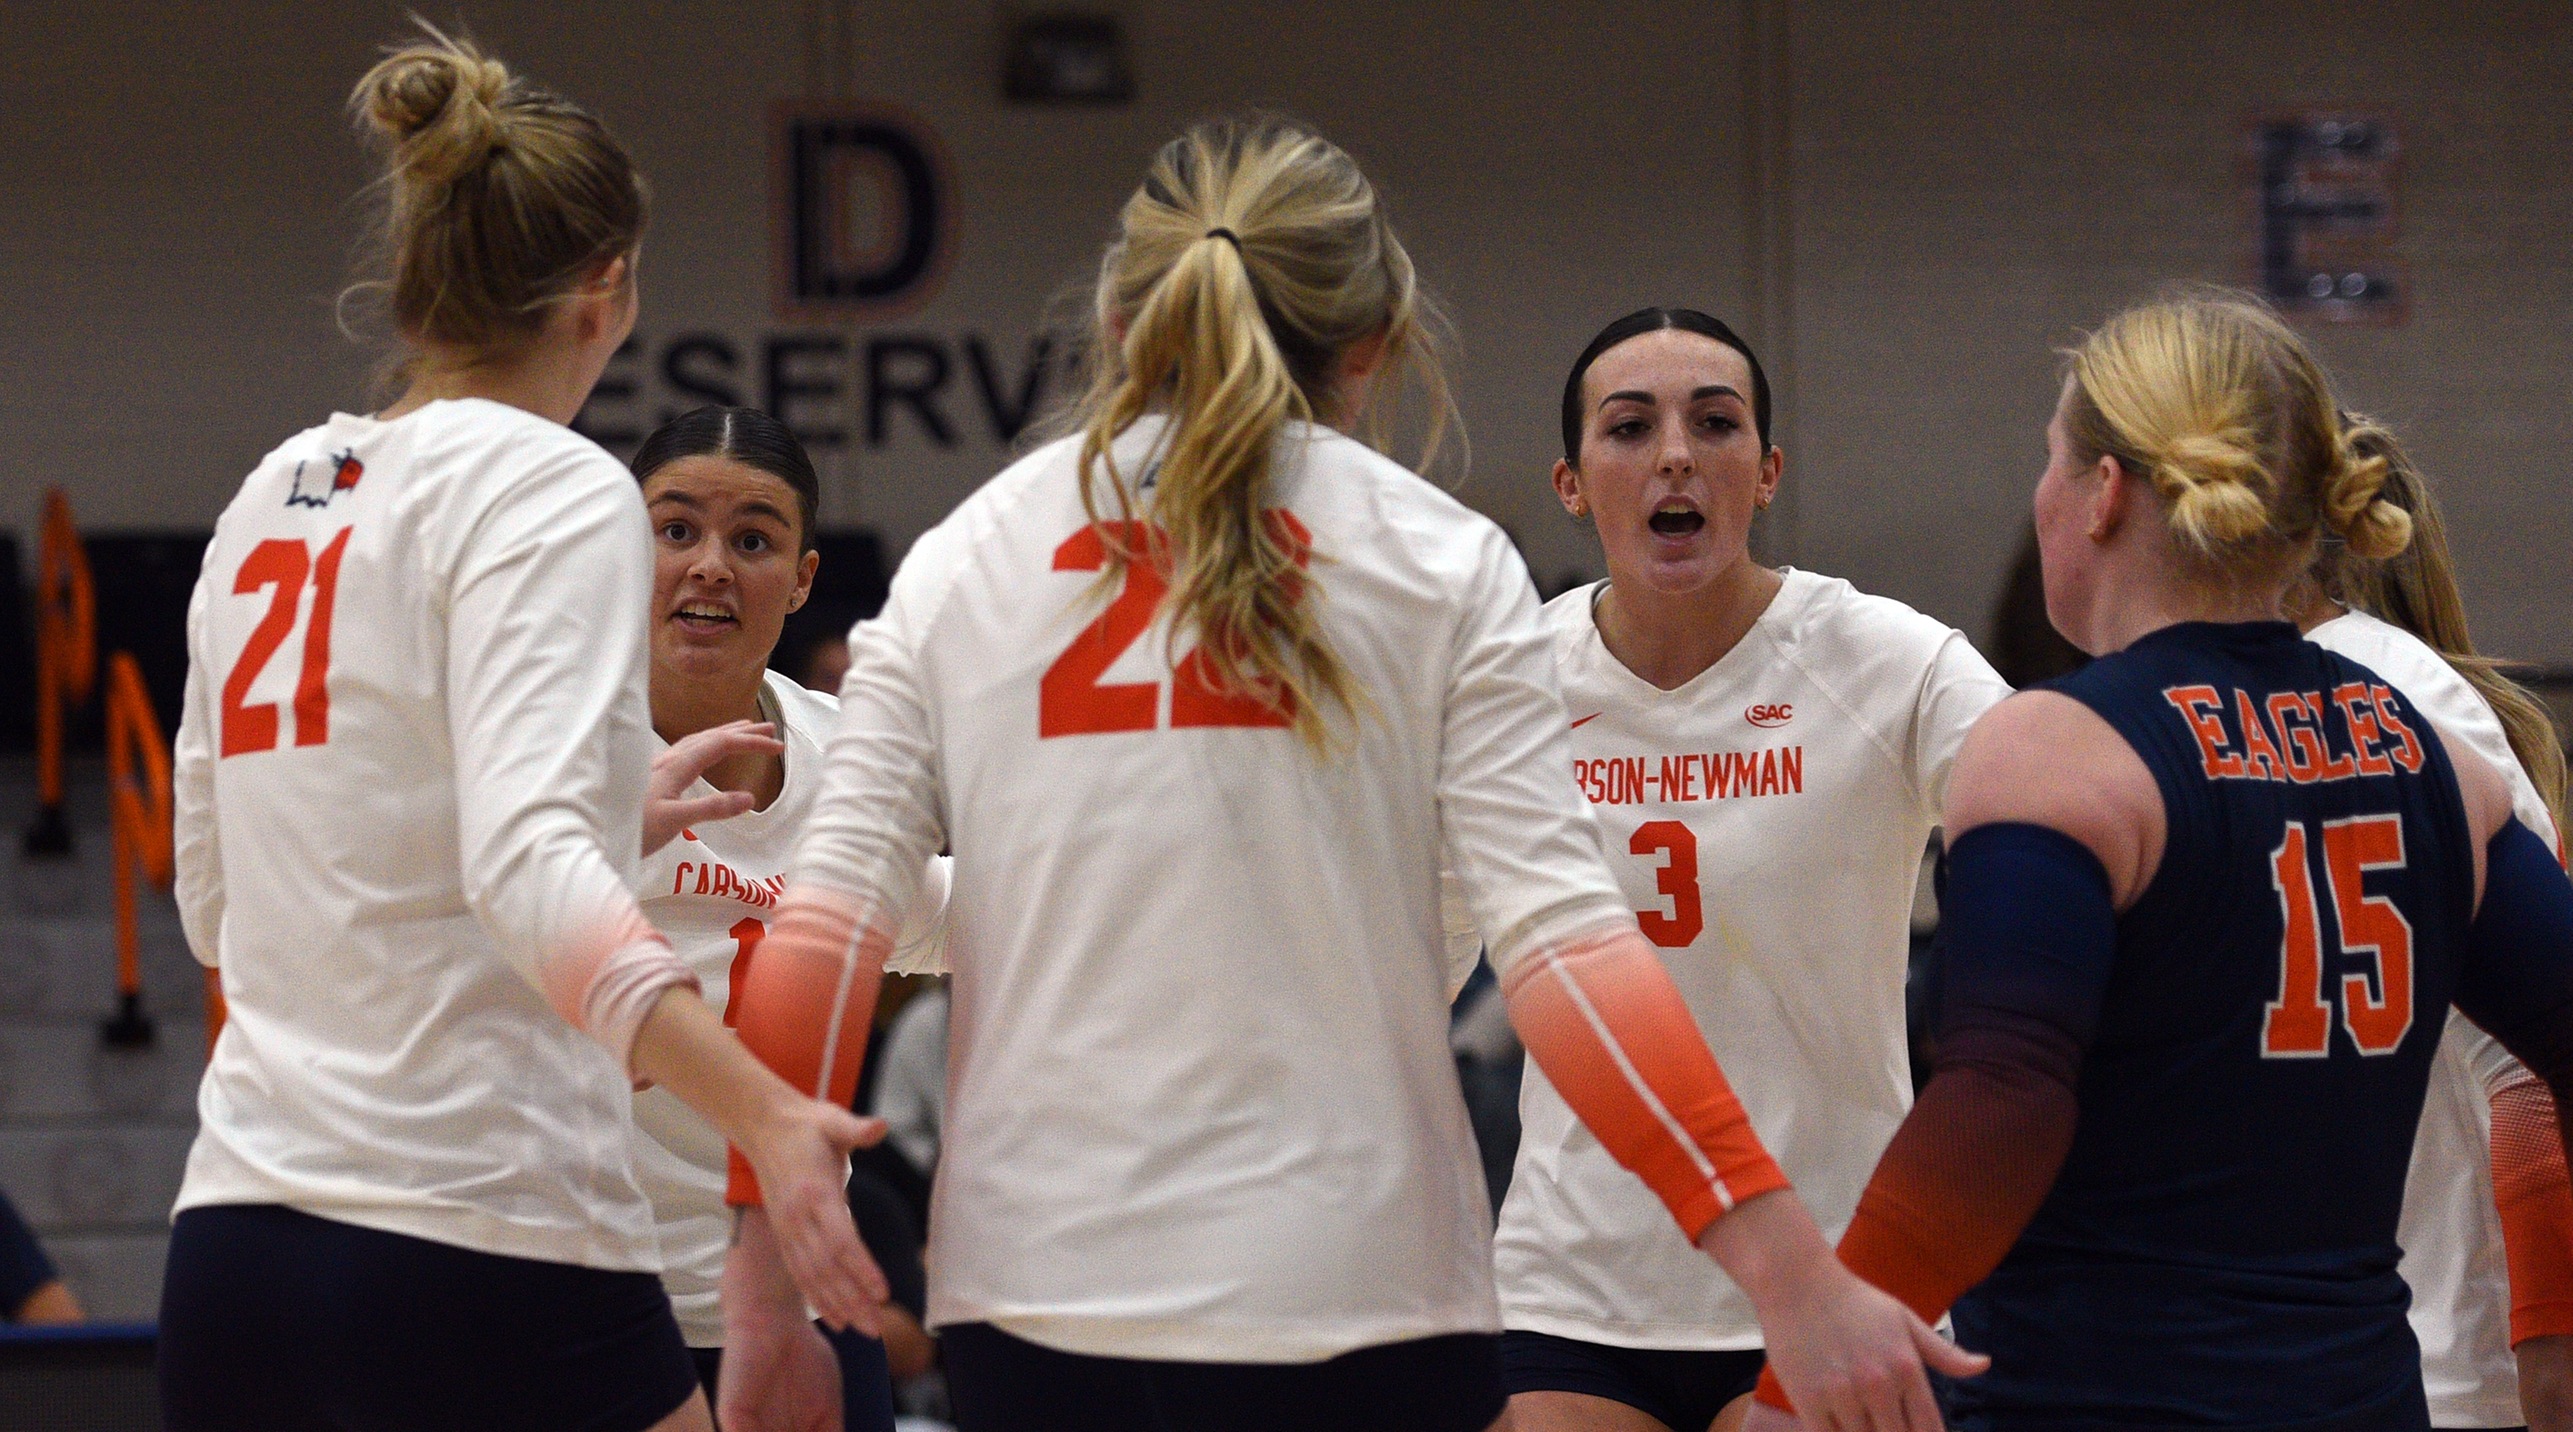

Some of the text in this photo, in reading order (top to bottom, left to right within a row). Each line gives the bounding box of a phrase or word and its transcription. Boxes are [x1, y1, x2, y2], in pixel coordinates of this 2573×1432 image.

[780, 106, 950, 314] D
[568, 332, 1052, 447] ESERV
[219, 524, 354, 760] 21
[1751, 703, 1794, 722] SAC
[2162, 681, 2426, 785] EAGLES
[1573, 745, 1803, 805] RSON-NEWMAN
[673, 861, 786, 910] CARSON
[1629, 820, 1704, 948] 3
[2260, 812, 2415, 1060] 15
